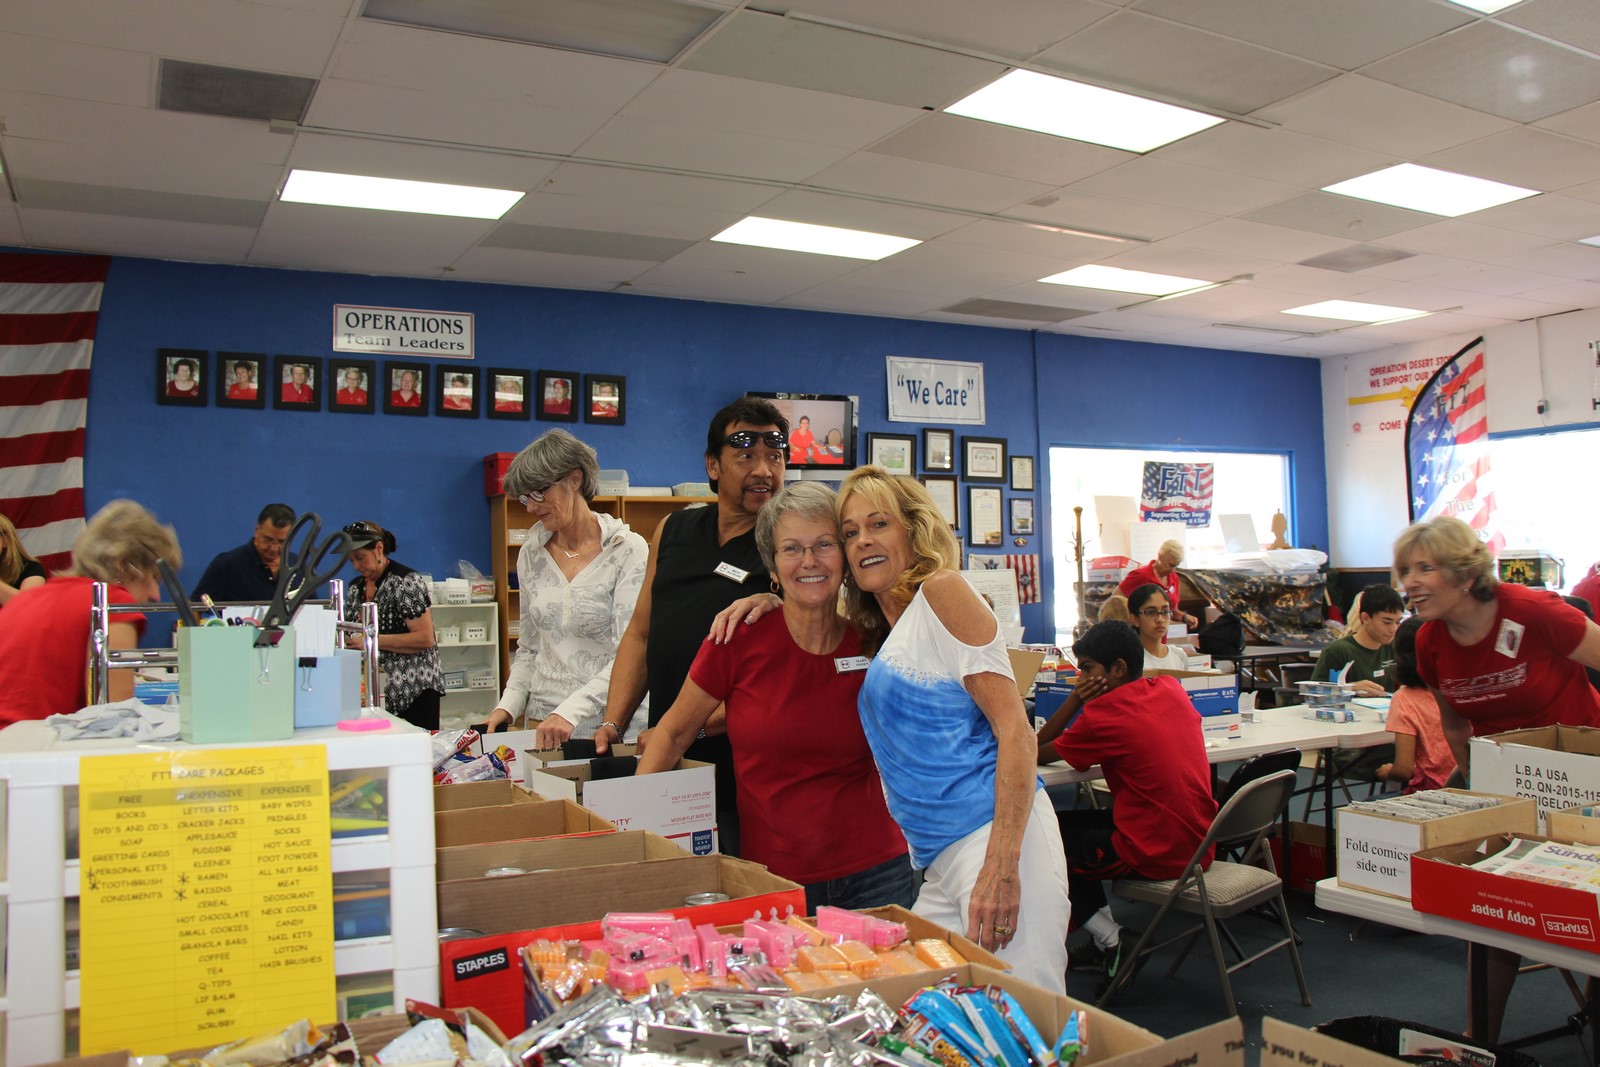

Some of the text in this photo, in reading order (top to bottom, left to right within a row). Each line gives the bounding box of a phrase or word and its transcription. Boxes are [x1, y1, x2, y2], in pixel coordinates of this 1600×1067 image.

[345, 312, 464, 335] OPERATIONS
[344, 333, 465, 350] Team Leaders
[1370, 362, 1407, 376] OPERATION
[1409, 358, 1433, 369] DESERT
[1370, 380, 1380, 388] WE
[1383, 374, 1412, 387] SUPPORT
[1415, 372, 1430, 381] OUR
[1379, 421, 1401, 431] COME
[1445, 499, 1474, 514] The
[151, 766, 265, 780] FTT CARE PACKAGES
[1515, 764, 1568, 782] L.B.A USA
[1515, 778, 1535, 790] P.O.
[177, 789, 243, 800] NEXPENSIVE
[261, 785, 311, 795] EXPENSIVE
[119, 795, 142, 804] FREE
[286, 800, 312, 808] WIPES
[183, 805, 239, 815] LETTER KITS
[178, 818, 245, 829] CRACKER JACKS
[267, 814, 307, 822] PRINGLES
[93, 826, 121, 835] DVD'S
[147, 823, 168, 831] CD'S
[274, 827, 301, 835] SOCKS
[120, 838, 143, 846] SOAP
[186, 831, 238, 842] APPLESAUCE
[264, 839, 312, 849] HOT SAUCE
[1345, 838, 1409, 861] Fold comics
[192, 845, 232, 855] PUDDING
[92, 850, 170, 862] GREETING CARDS
[257, 852, 318, 863] FOOT POWDER
[194, 859, 231, 868] KLEENEX
[1356, 858, 1397, 877] side out
[95, 864, 167, 876] PERSONAL KITS
[276, 867, 293, 875] NUT
[297, 865, 318, 873] BAGS
[197, 873, 228, 881] RAMEN
[101, 878, 163, 889] TOOTHBRUSH
[278, 879, 300, 887] MEAT
[194, 886, 232, 895] RAISINS
[100, 892, 163, 903] CONDIMENTS
[263, 891, 315, 902] DEODORANT
[198, 900, 228, 908] CEREAL
[261, 904, 317, 916] NECK COOLER
[177, 910, 250, 924] HOT CHOCOLATE
[1471, 903, 1589, 935] STAPLES copy paper
[276, 919, 304, 927] CANDY
[178, 924, 249, 937] SMALL COOKIES
[268, 931, 313, 941] NAIL KITS
[180, 938, 247, 951] GRANOLA BARS
[274, 945, 308, 954] LOTION
[198, 952, 230, 962] COFFEE
[259, 956, 322, 969] HAIR BRUSHES
[456, 953, 506, 974] STAPLES
[207, 967, 223, 975] TEA
[198, 980, 232, 990] Q-TIPS
[195, 993, 235, 1004] LIP BALM
[206, 1007, 226, 1015] GUM
[198, 1019, 235, 1030] SCRUBBY
[1271, 1042, 1295, 1059] you
[1299, 1050, 1318, 1066] for
